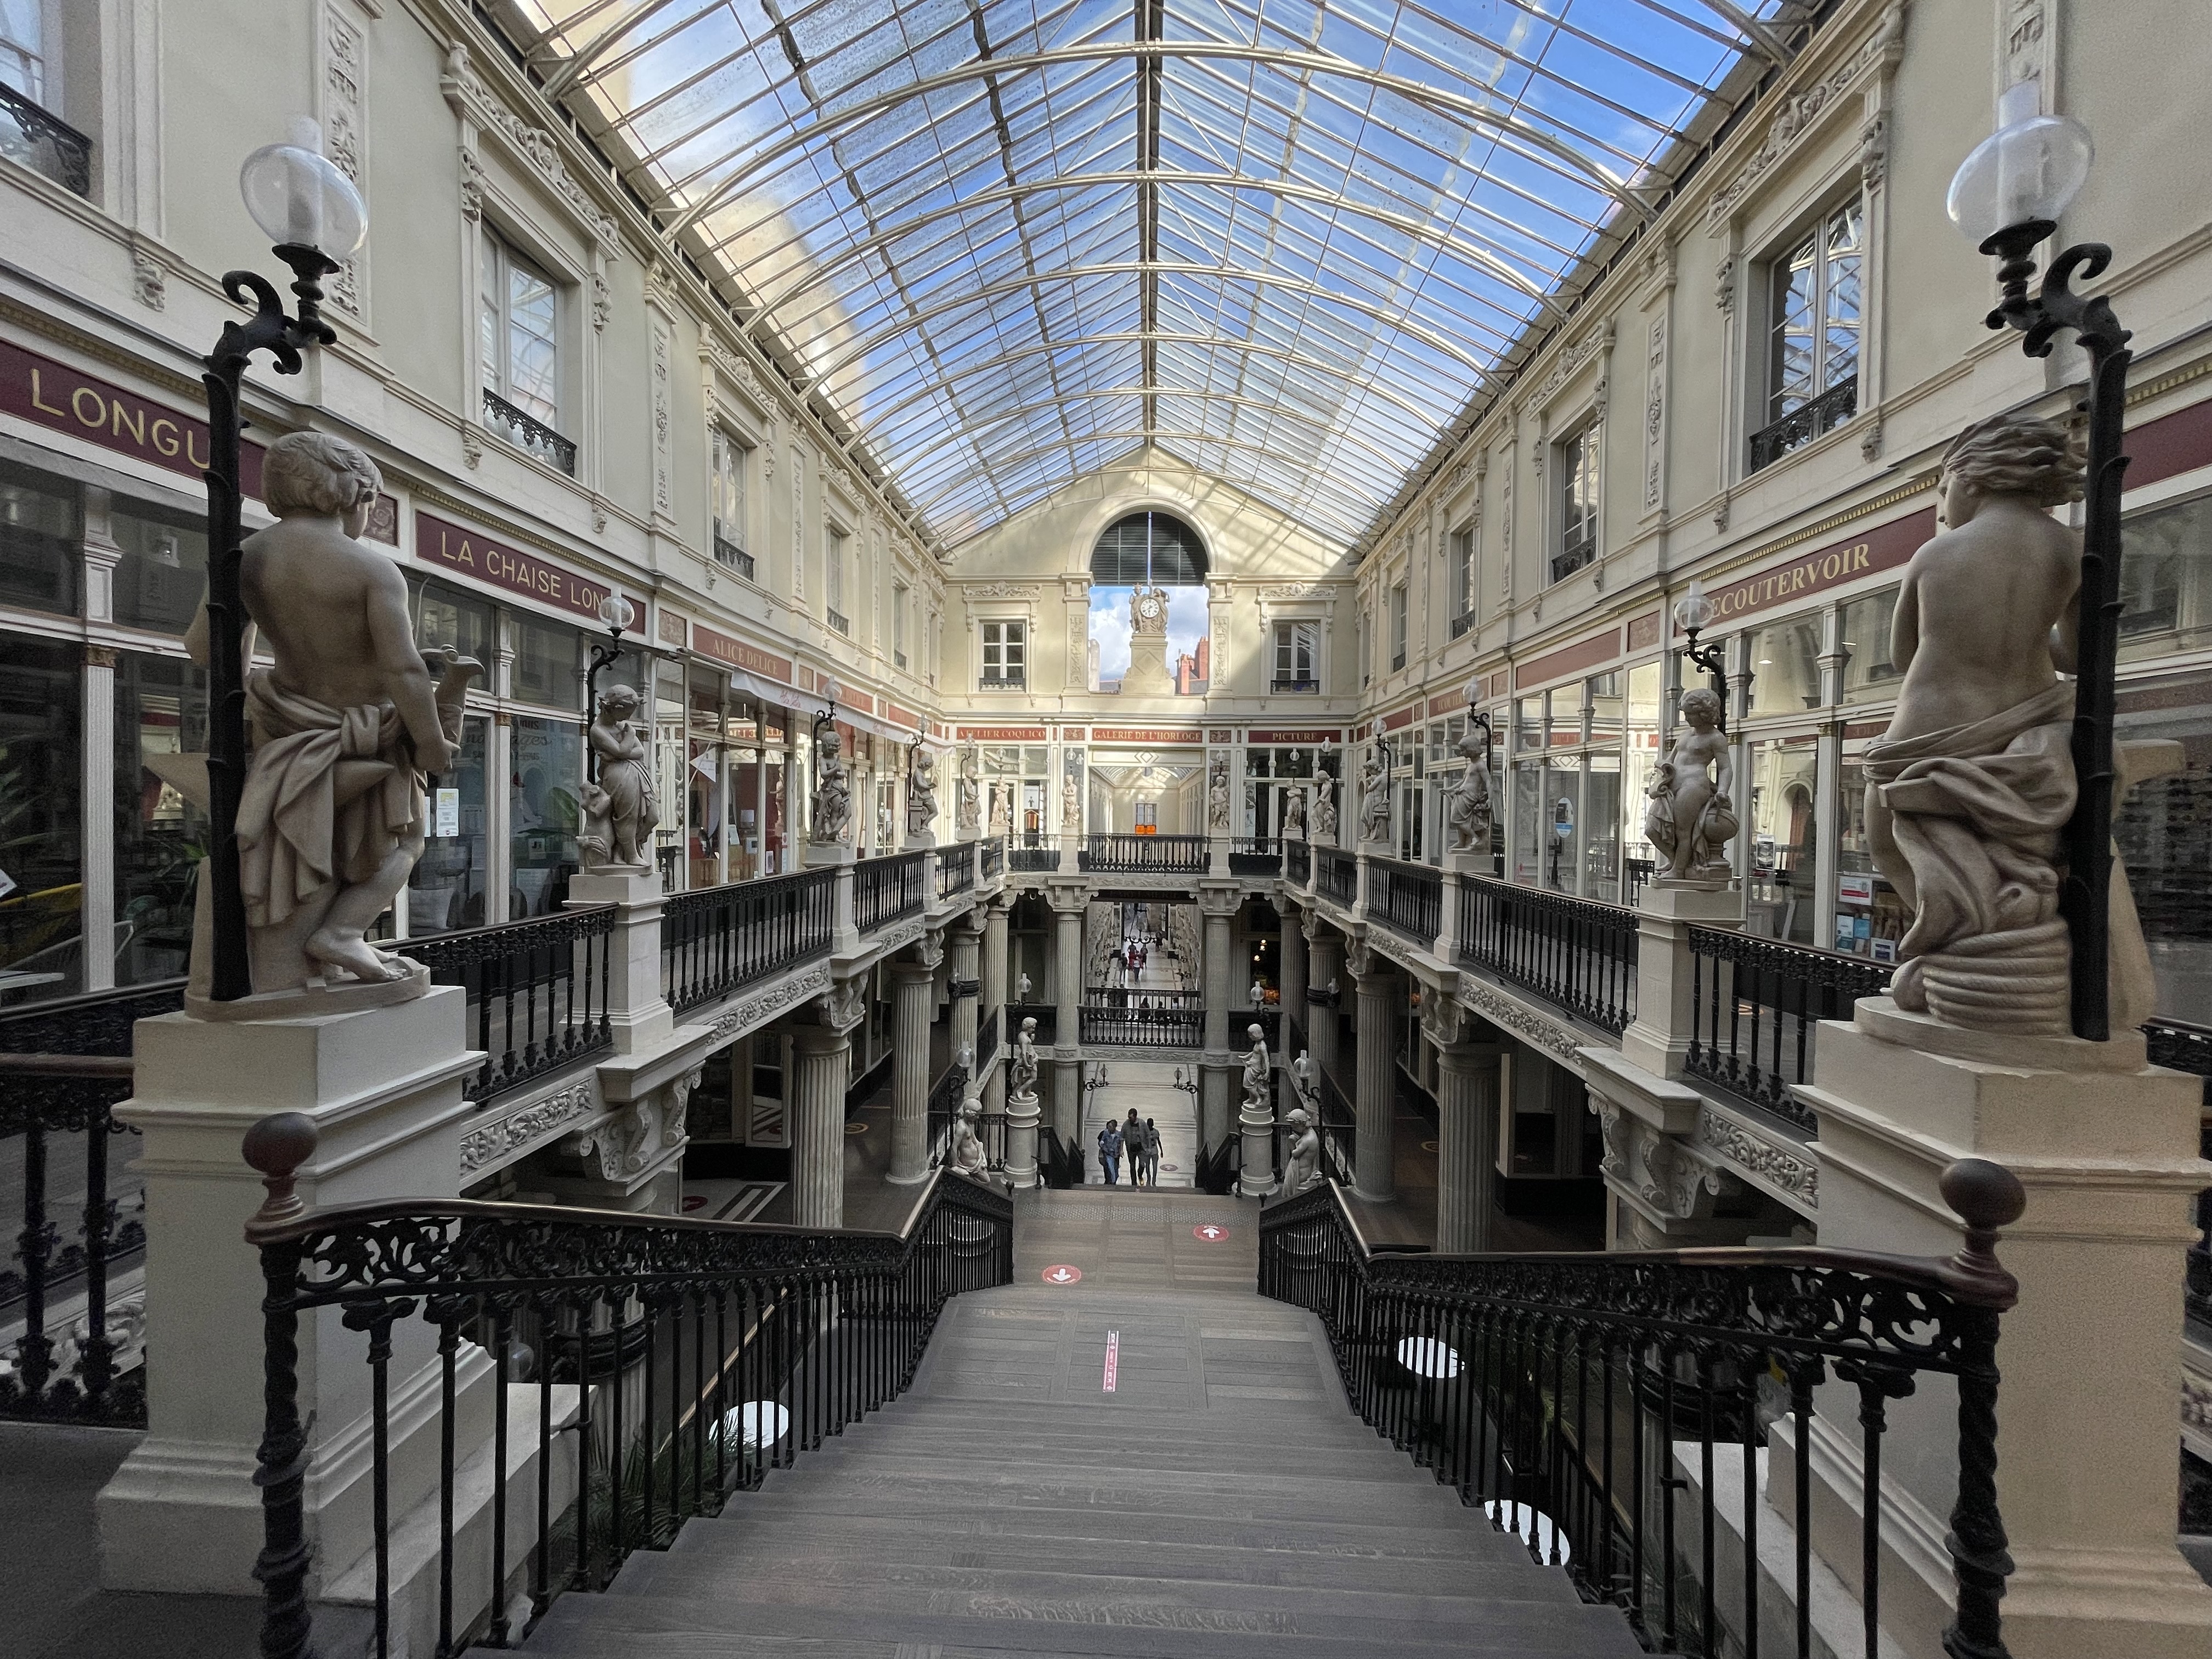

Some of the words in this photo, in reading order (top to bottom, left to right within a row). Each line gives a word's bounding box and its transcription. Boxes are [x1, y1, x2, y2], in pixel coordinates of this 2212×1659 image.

[30, 368, 210, 469] LONGU
[441, 531, 475, 567] LA
[486, 550, 562, 599] CHAISE
[570, 582, 605, 612] LON
[1708, 543, 1870, 618] ECOUTERVOIR
[712, 639, 744, 663] ALICE
[747, 650, 778, 675] DELICE
[1093, 731, 1133, 740] GALERIE
[1135, 731, 1147, 740] DE
[1149, 731, 1201, 741] L'HORLOGE
[1272, 732, 1317, 741] PICTURE
